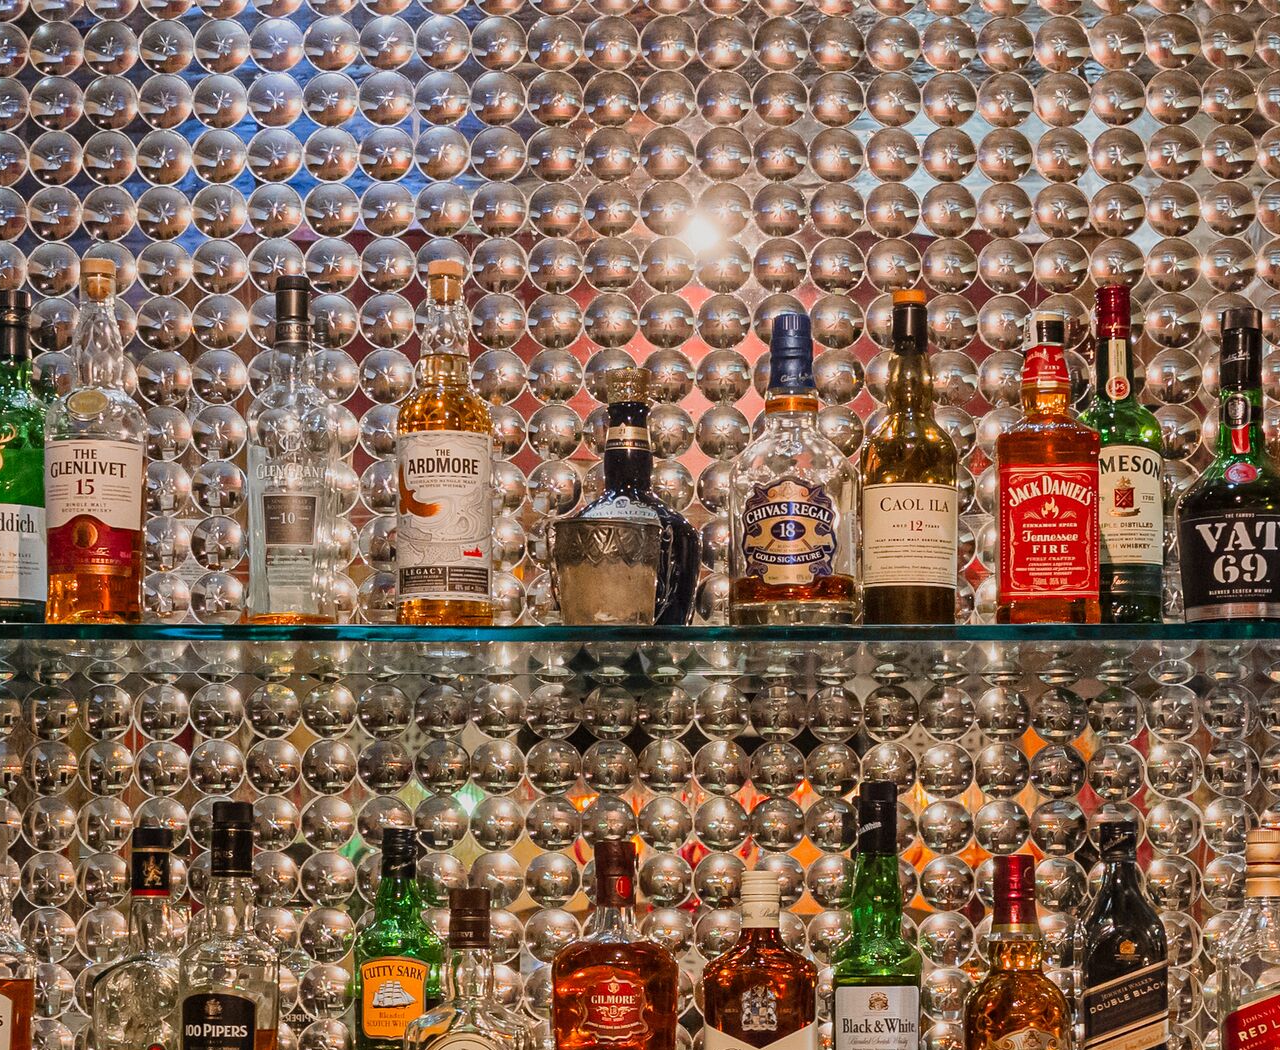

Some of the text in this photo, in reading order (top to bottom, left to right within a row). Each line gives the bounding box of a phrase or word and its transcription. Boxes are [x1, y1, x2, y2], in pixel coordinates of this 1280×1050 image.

[73, 449, 97, 459] THE
[51, 461, 126, 478] GLENLIVET
[408, 458, 480, 475] ARDMORE
[1100, 455, 1160, 481] MESON
[76, 479, 95, 495] 15
[1008, 475, 1094, 507] JACK DANIEL'S
[880, 497, 949, 513] CAOL ILA
[280, 512, 295, 523] 10
[746, 503, 831, 525] CHIVAS REGAL
[780, 523, 795, 537] 18
[910, 520, 923, 531] 12
[1022, 530, 1079, 543] Tennessee
[1032, 544, 1069, 554] FIRE
[755, 551, 822, 563] GOLD SIGNATURE
[405, 567, 444, 576] LEGACY
[1213, 554, 1268, 583] 69
[364, 965, 423, 981] CUTTY SARK
[591, 994, 636, 1004] GILMORE
[1089, 980, 1166, 1014] DOUBLE BLACK
[185, 1023, 248, 1038] 100 PIPERS
[842, 1018, 916, 1033] Black & White
[1238, 1023, 1268, 1042] RED
